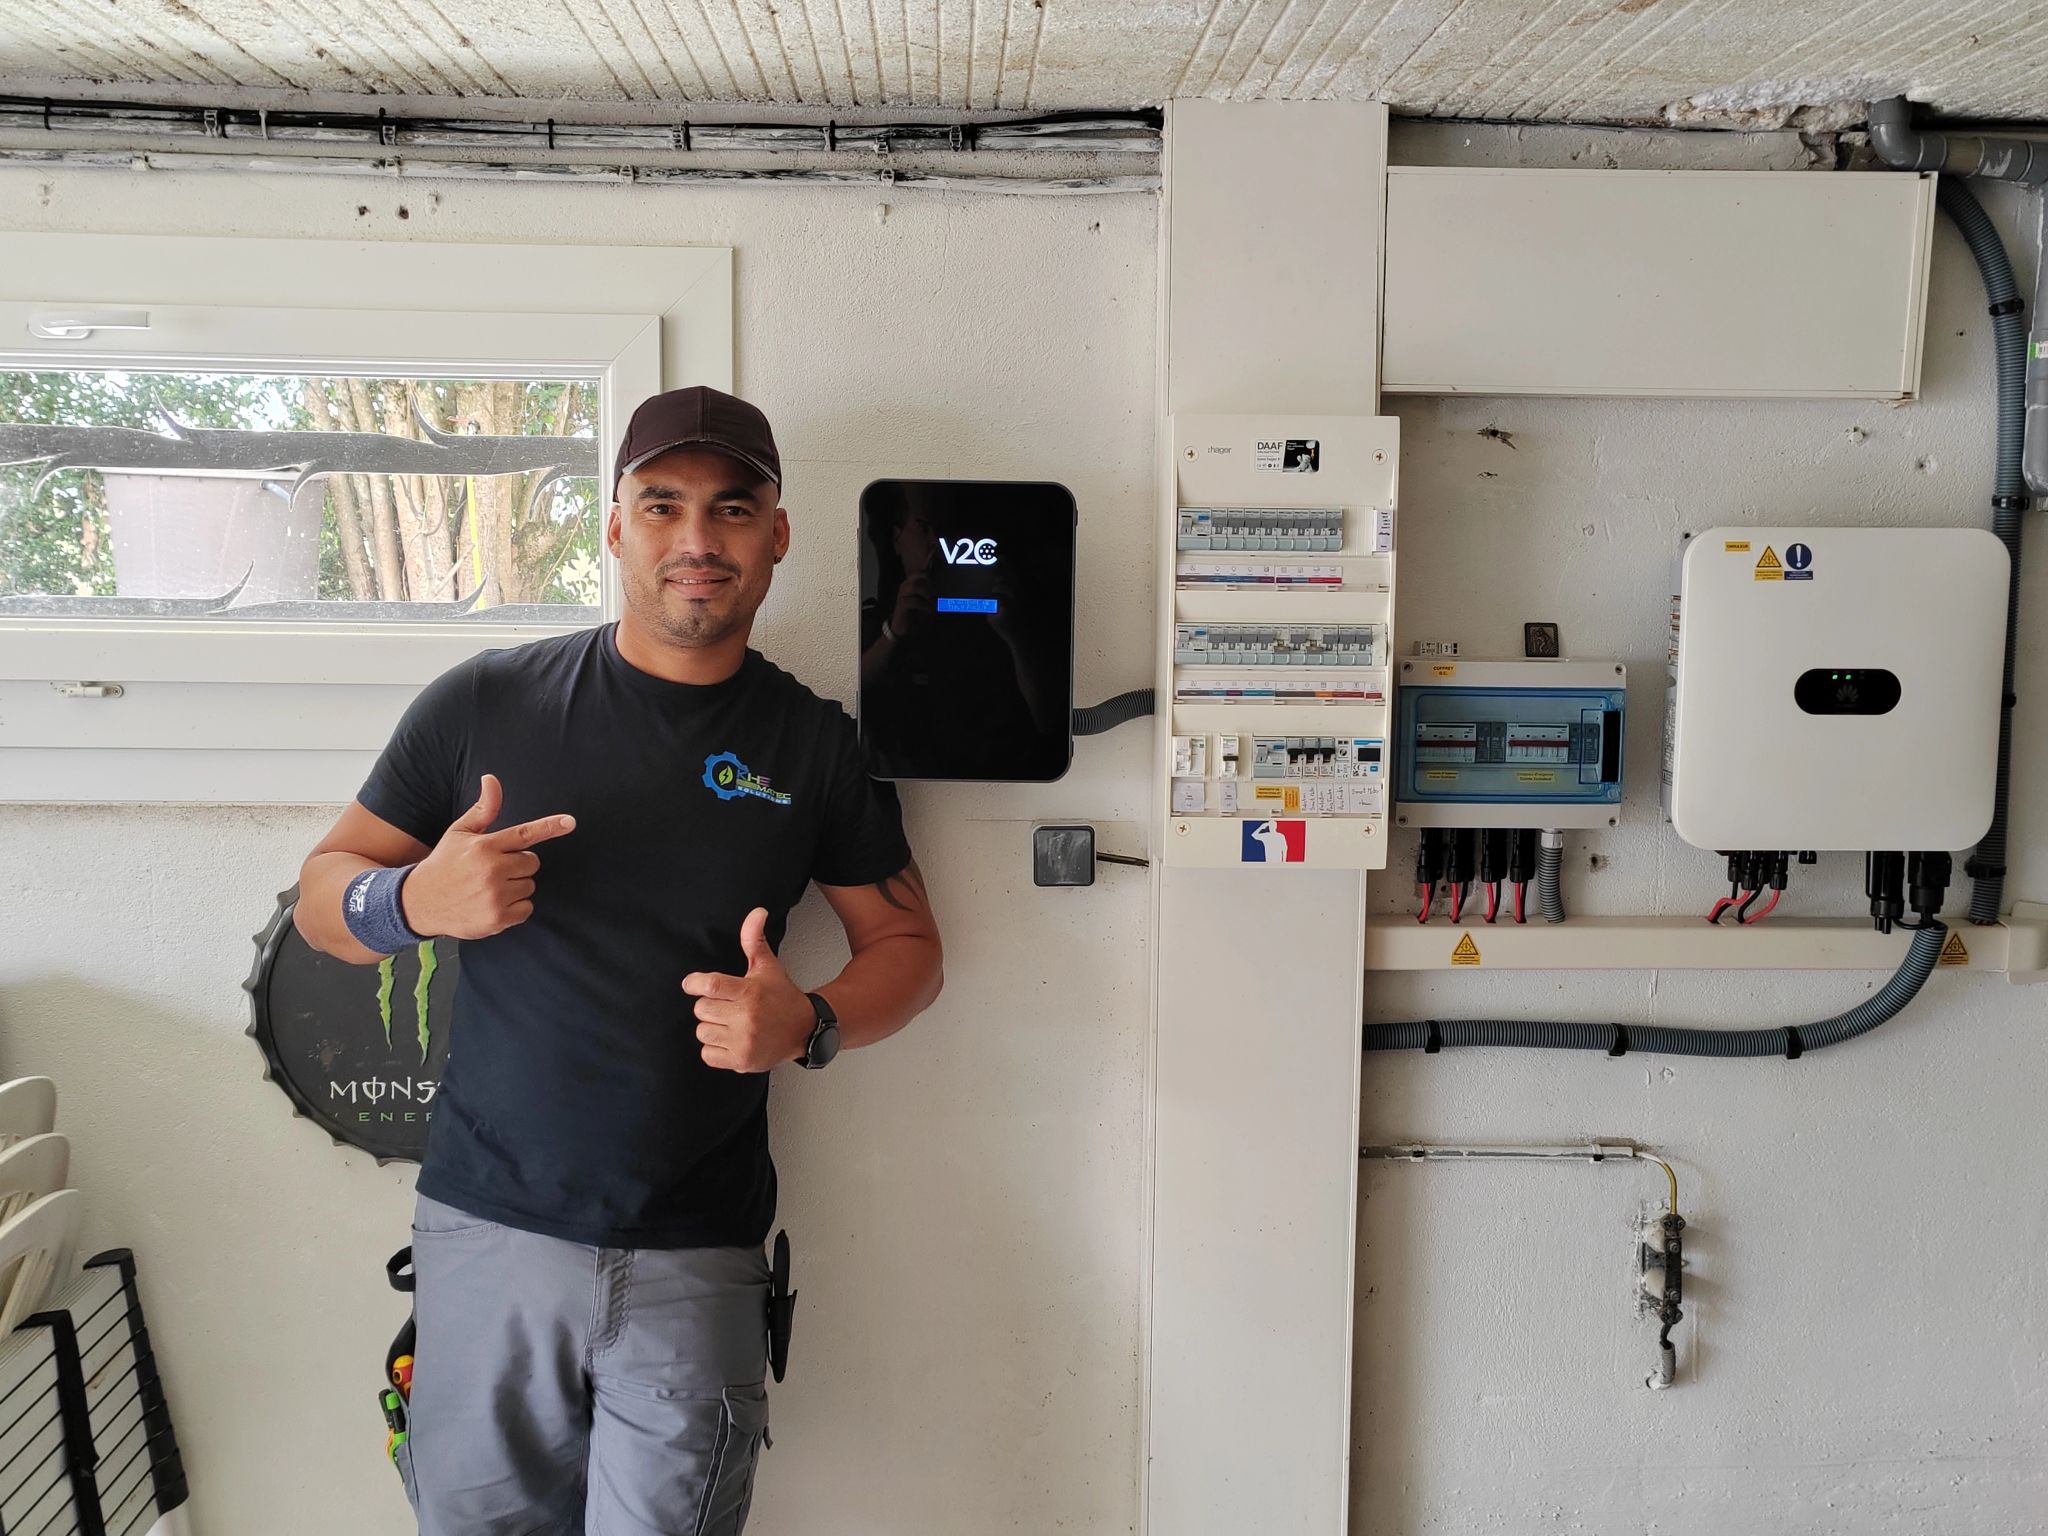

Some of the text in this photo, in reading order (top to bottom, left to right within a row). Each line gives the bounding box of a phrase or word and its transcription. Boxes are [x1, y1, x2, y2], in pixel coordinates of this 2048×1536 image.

[1257, 442, 1283, 450] DAAF
[938, 537, 998, 565] V2C
[330, 1076, 441, 1105] MONS
